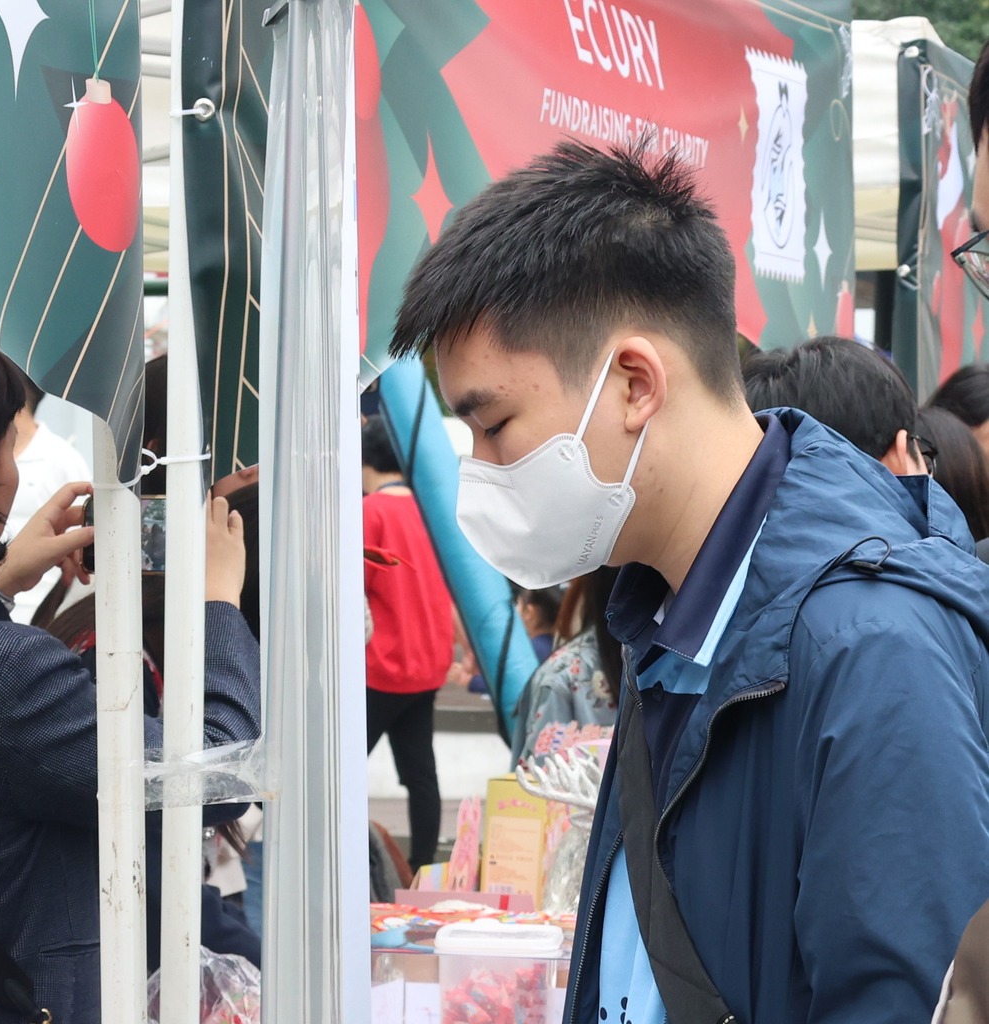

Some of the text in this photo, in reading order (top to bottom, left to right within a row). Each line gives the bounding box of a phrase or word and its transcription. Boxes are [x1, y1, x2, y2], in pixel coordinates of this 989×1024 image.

[564, 0, 664, 91] ECURY
[539, 87, 709, 167] FUNDRAISING FOR CHARITY
